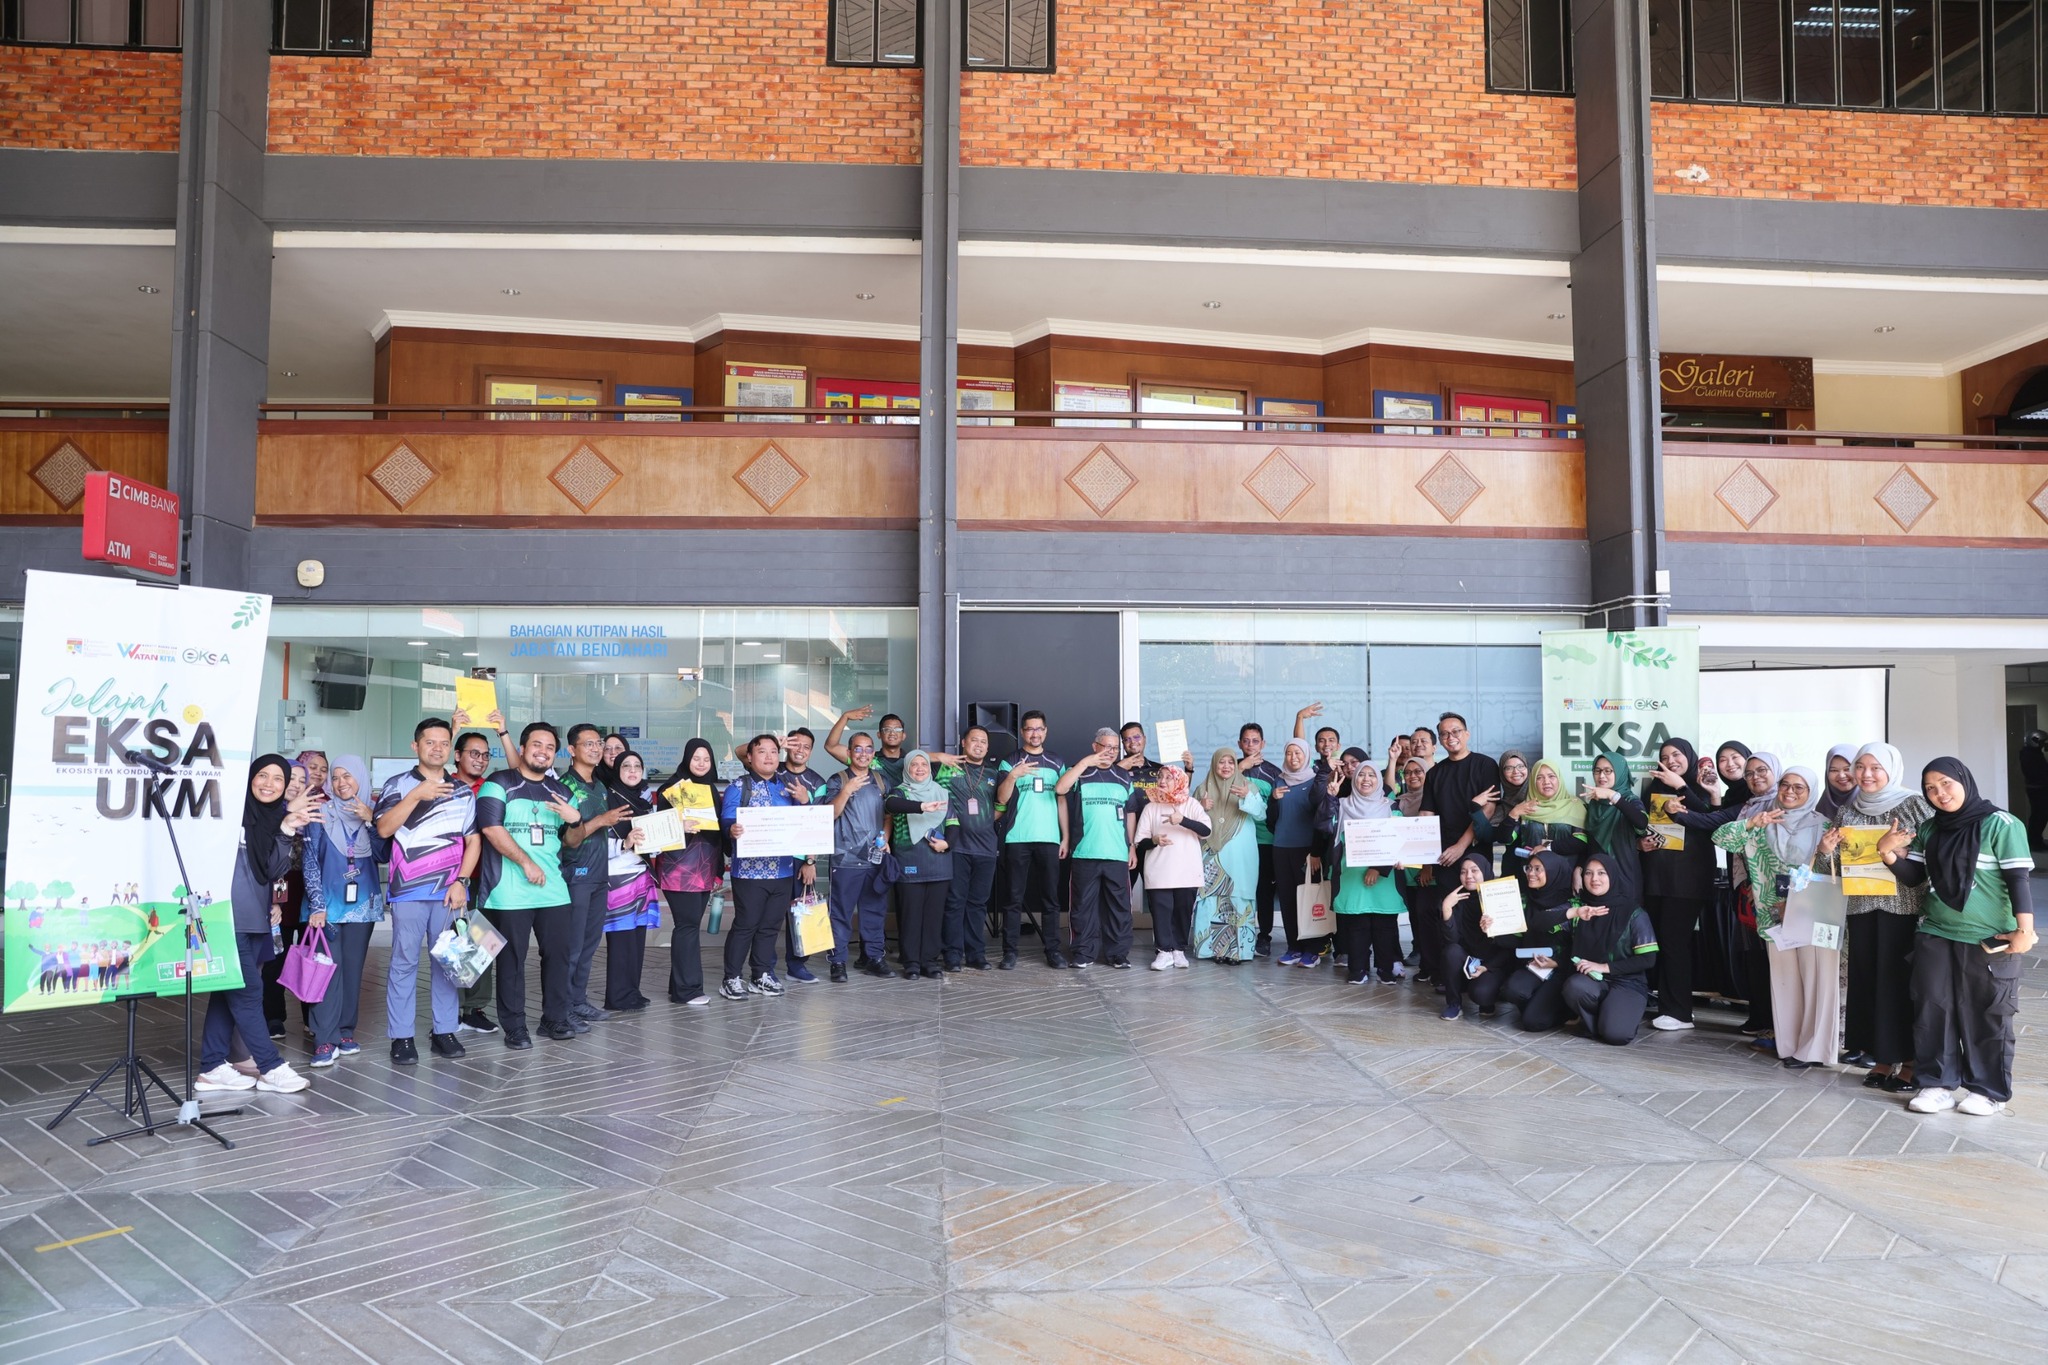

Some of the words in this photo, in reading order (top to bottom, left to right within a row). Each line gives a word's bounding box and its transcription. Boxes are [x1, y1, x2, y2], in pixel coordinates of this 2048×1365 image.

[1660, 359, 1755, 392] Galeri
[1692, 386, 1734, 397] Tuanku
[1736, 387, 1777, 399] Canselor
[122, 485, 149, 506] CIMB
[151, 494, 176, 514] BANK
[107, 540, 130, 560] ATM
[510, 625, 572, 637] BAHAGIAN
[576, 625, 628, 638] KUTIPAN
[632, 626, 667, 638] HASIL
[510, 642, 576, 657] JABATAN
[582, 643, 668, 657] BENDAHARI
[42, 677, 168, 726] Jelajah
[52, 716, 224, 768] EKSA
[1560, 722, 1671, 758] EKSA
[97, 778, 222, 820] UKM
